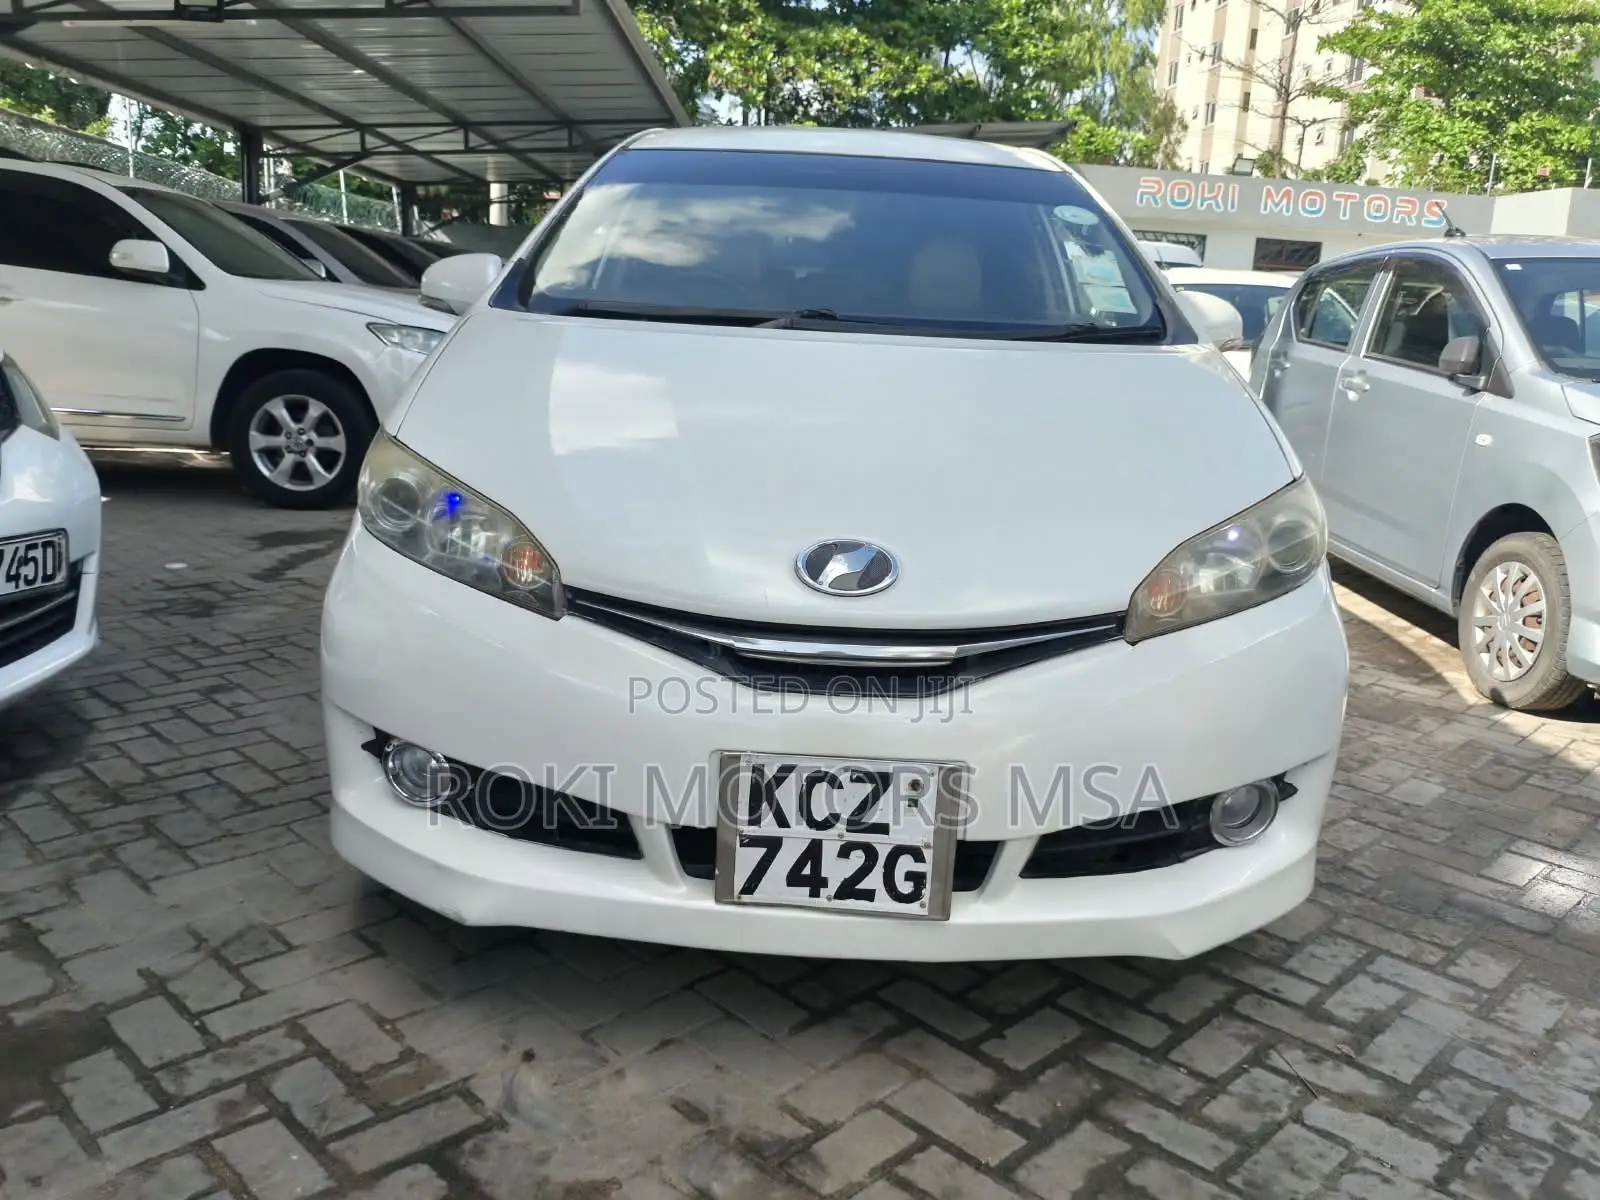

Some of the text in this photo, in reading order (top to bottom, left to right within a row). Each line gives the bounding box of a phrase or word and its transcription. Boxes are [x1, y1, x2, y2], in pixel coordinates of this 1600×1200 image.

[1136, 176, 1448, 228] ROKI MOTORS
[748, 763, 893, 835] KCZ
[738, 835, 928, 904] 742G
